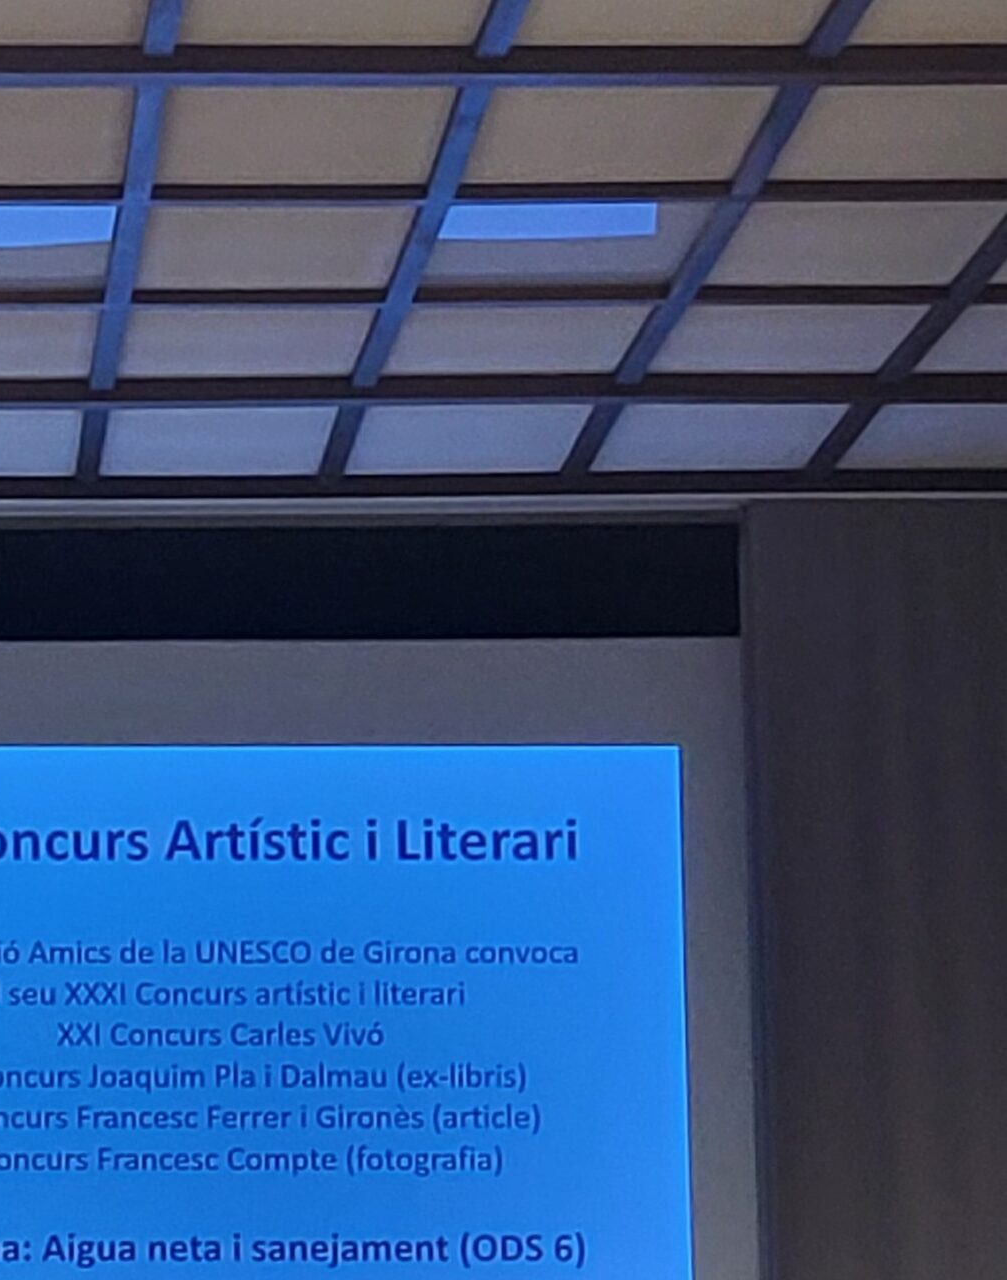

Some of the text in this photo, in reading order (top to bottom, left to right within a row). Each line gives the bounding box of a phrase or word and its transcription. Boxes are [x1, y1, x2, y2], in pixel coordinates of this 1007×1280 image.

[164, 816, 350, 862] Artístic
[366, 818, 378, 861] i
[397, 817, 577, 862] Literari
[27, 939, 112, 965] Amics
[119, 938, 155, 965] de
[163, 938, 186, 964] la
[195, 940, 312, 965] UNESCO
[320, 938, 355, 964] de
[363, 940, 456, 965] Girona
[465, 946, 579, 965] convoca
[8, 987, 57, 1006] seu
[64, 981, 126, 1006] XXXI
[135, 982, 248, 1006] Concurs
[255, 979, 351, 1006] artístic
[359, 981, 365, 1006] i
[374, 979, 465, 1006] literari
[57, 1020, 384, 1047] XXI Concurs Carles Vivó
[88, 1063, 206, 1094] Joaquim
[215, 1060, 256, 1089] Pla
[264, 1063, 272, 1088] i
[281, 1061, 387, 1089] Dalmau
[397, 1061, 526, 1094] (ex-libris)
[77, 1104, 199, 1130] Francesc
[207, 1104, 293, 1130] Ferrer
[300, 1104, 307, 1129] i
[315, 1103, 425, 1130] Gironès
[432, 1103, 541, 1135] (article)
[97, 1146, 219, 1171] Francesc
[227, 1146, 338, 1177] Compte
[346, 1144, 503, 1178] (fotografia)
[41, 1232, 136, 1269] Aigua
[148, 1235, 221, 1263] neta
[232, 1232, 241, 1263] i
[251, 1232, 450, 1269] sanejament
[460, 1231, 544, 1269] (ODS
[554, 1231, 586, 1270] 6)
